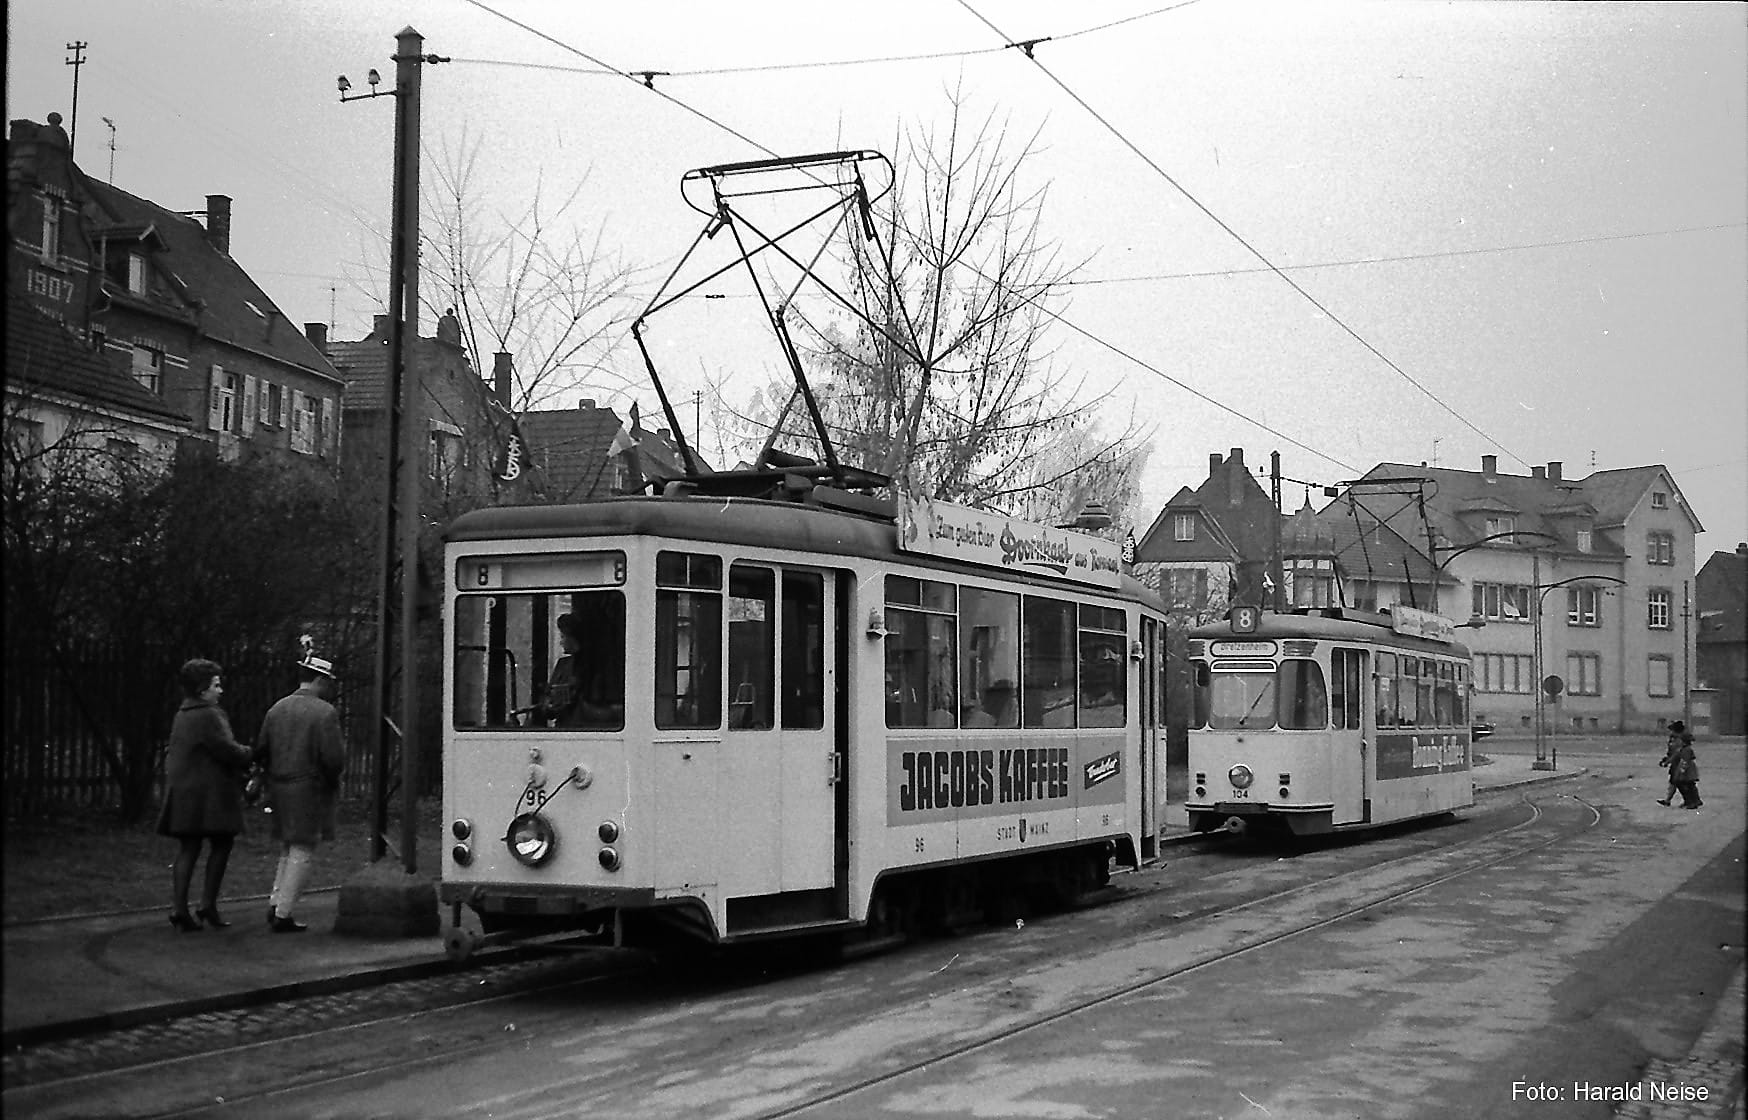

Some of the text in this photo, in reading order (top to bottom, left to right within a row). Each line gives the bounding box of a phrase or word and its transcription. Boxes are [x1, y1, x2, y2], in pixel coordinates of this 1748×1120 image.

[27, 269, 74, 304] 1907
[478, 563, 489, 586] 8
[614, 558, 626, 582] 8
[1239, 609, 1251, 628] 8
[900, 747, 1068, 812] JACOBS KAFFEE
[527, 789, 546, 806] 96
[1232, 789, 1248, 799] 104
